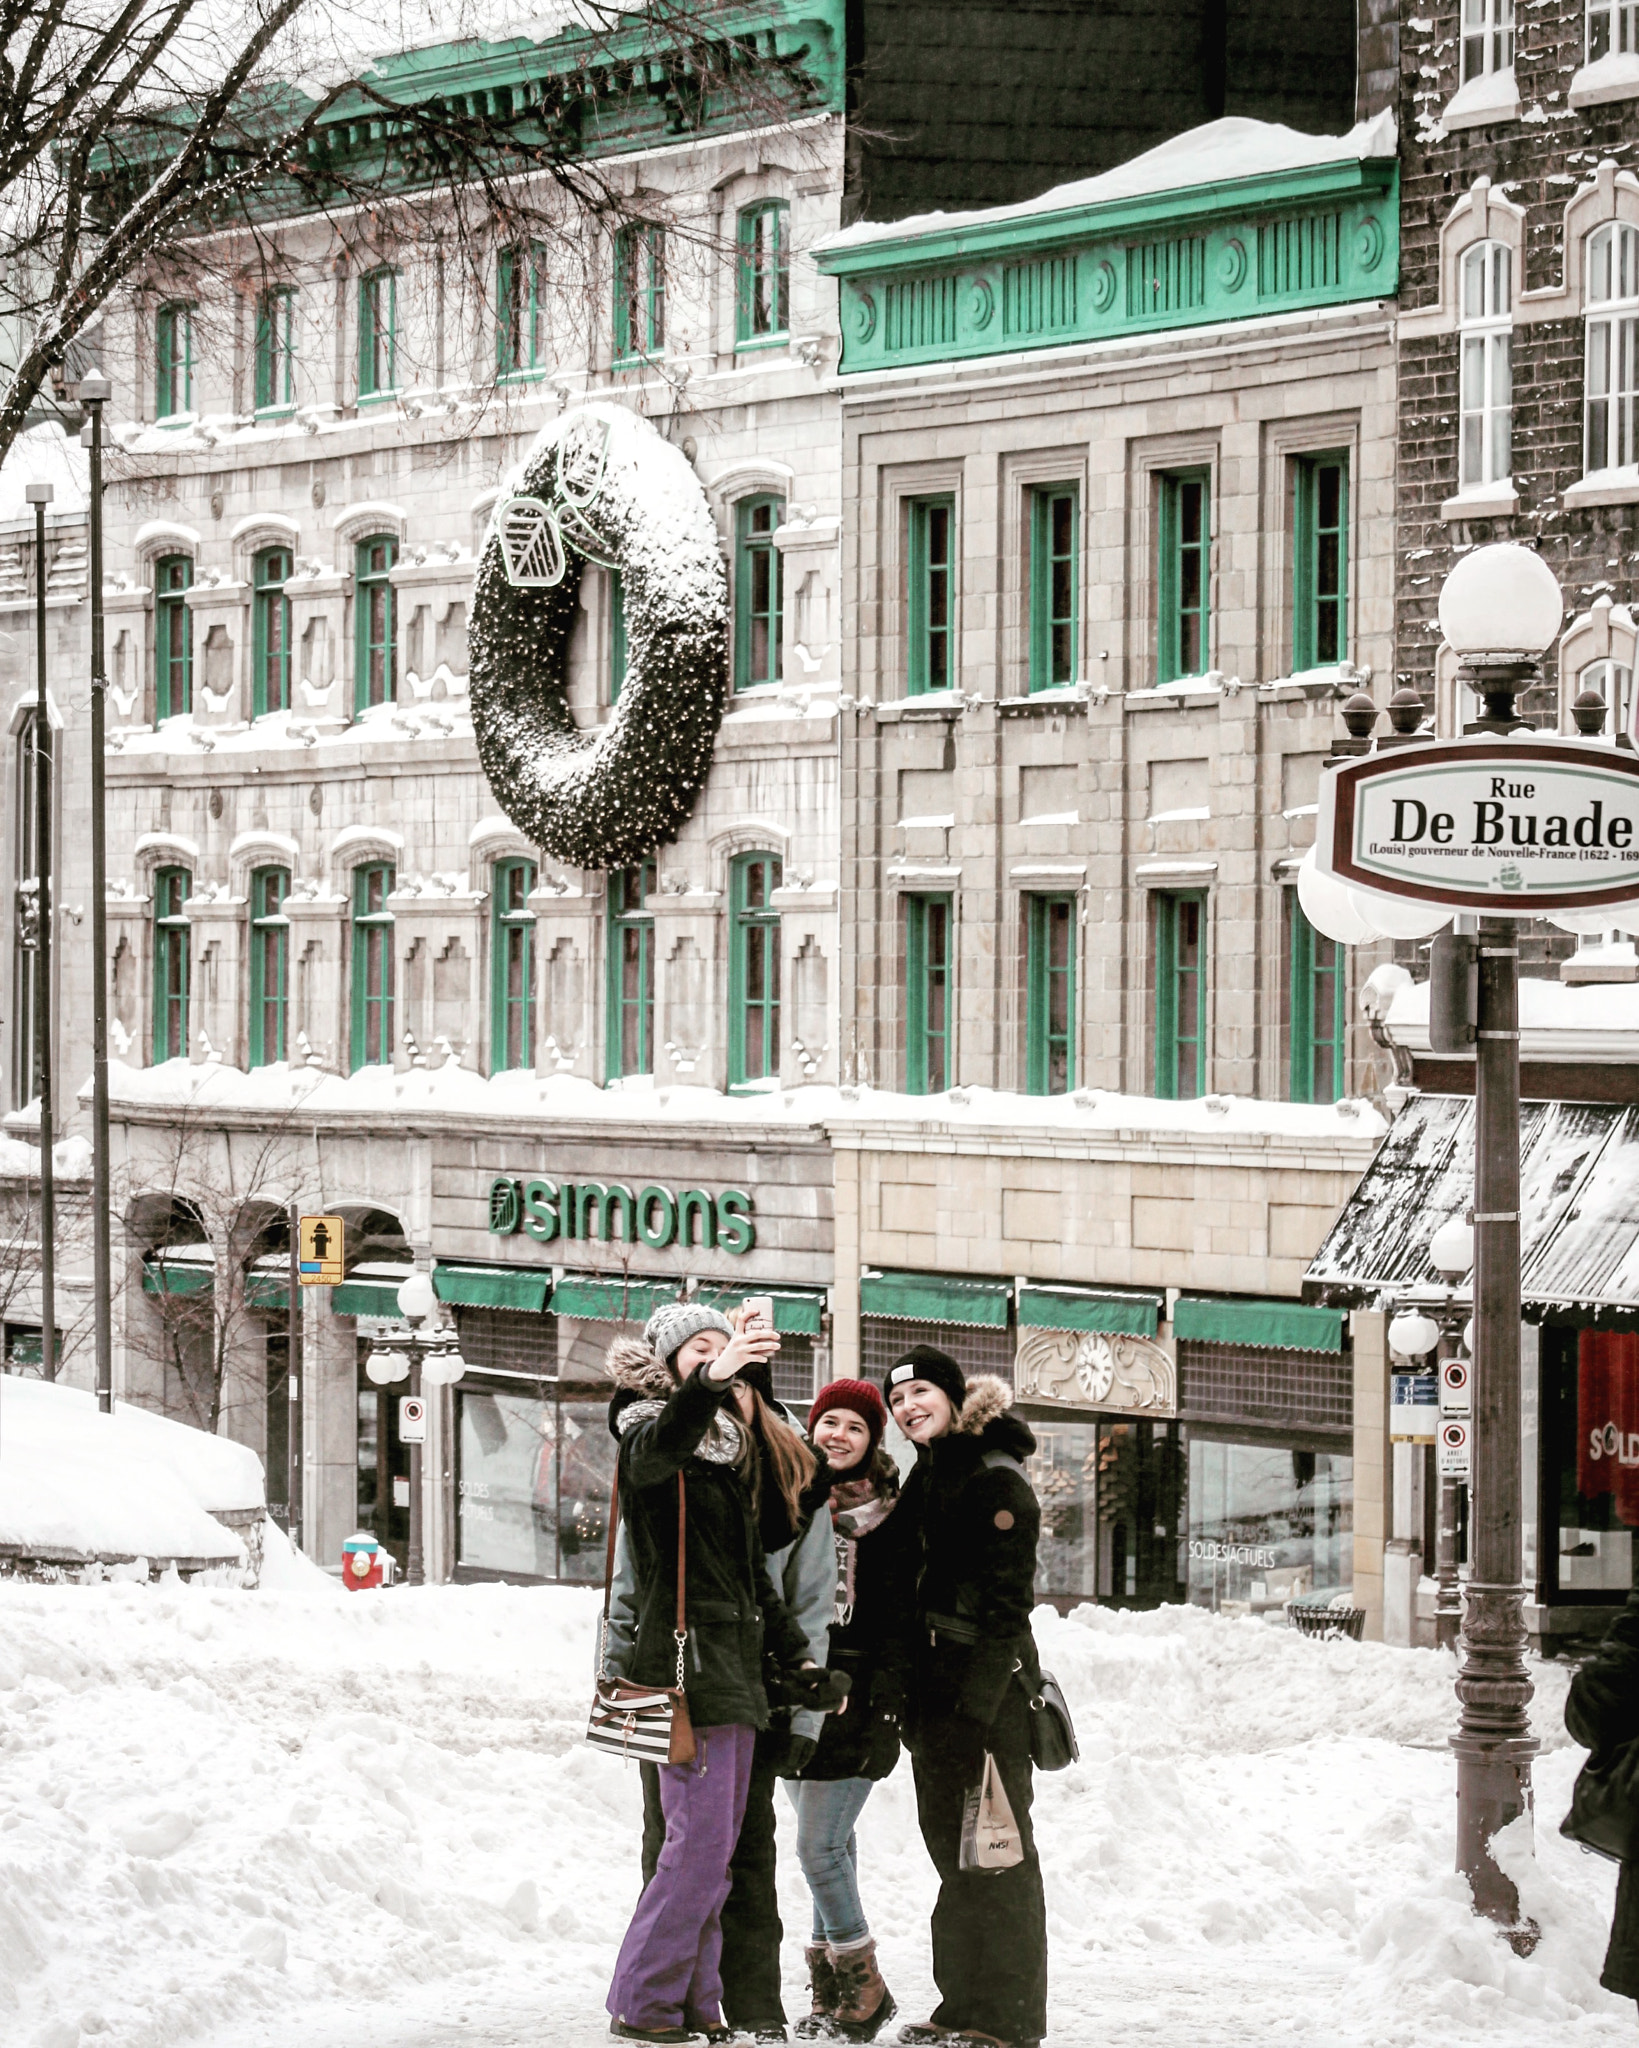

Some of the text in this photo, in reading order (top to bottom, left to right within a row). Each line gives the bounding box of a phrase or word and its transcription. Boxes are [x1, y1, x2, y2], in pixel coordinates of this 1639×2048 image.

[1490, 778, 1535, 798] Rue
[1390, 799, 1632, 848] De Buade
[1370, 843, 1406, 856] (Louis)
[1408, 846, 1468, 858] gouverneur
[1472, 846, 1484, 857] de
[1488, 847, 1576, 860] Nouvelle-France
[1579, 849, 1609, 861] (1622
[525, 1179, 755, 1254] simons
[311, 1275, 331, 1283] 2450
[459, 1480, 489, 1498] SOLDES
[1189, 1540, 1275, 1568] SOLDES ACTUELS
